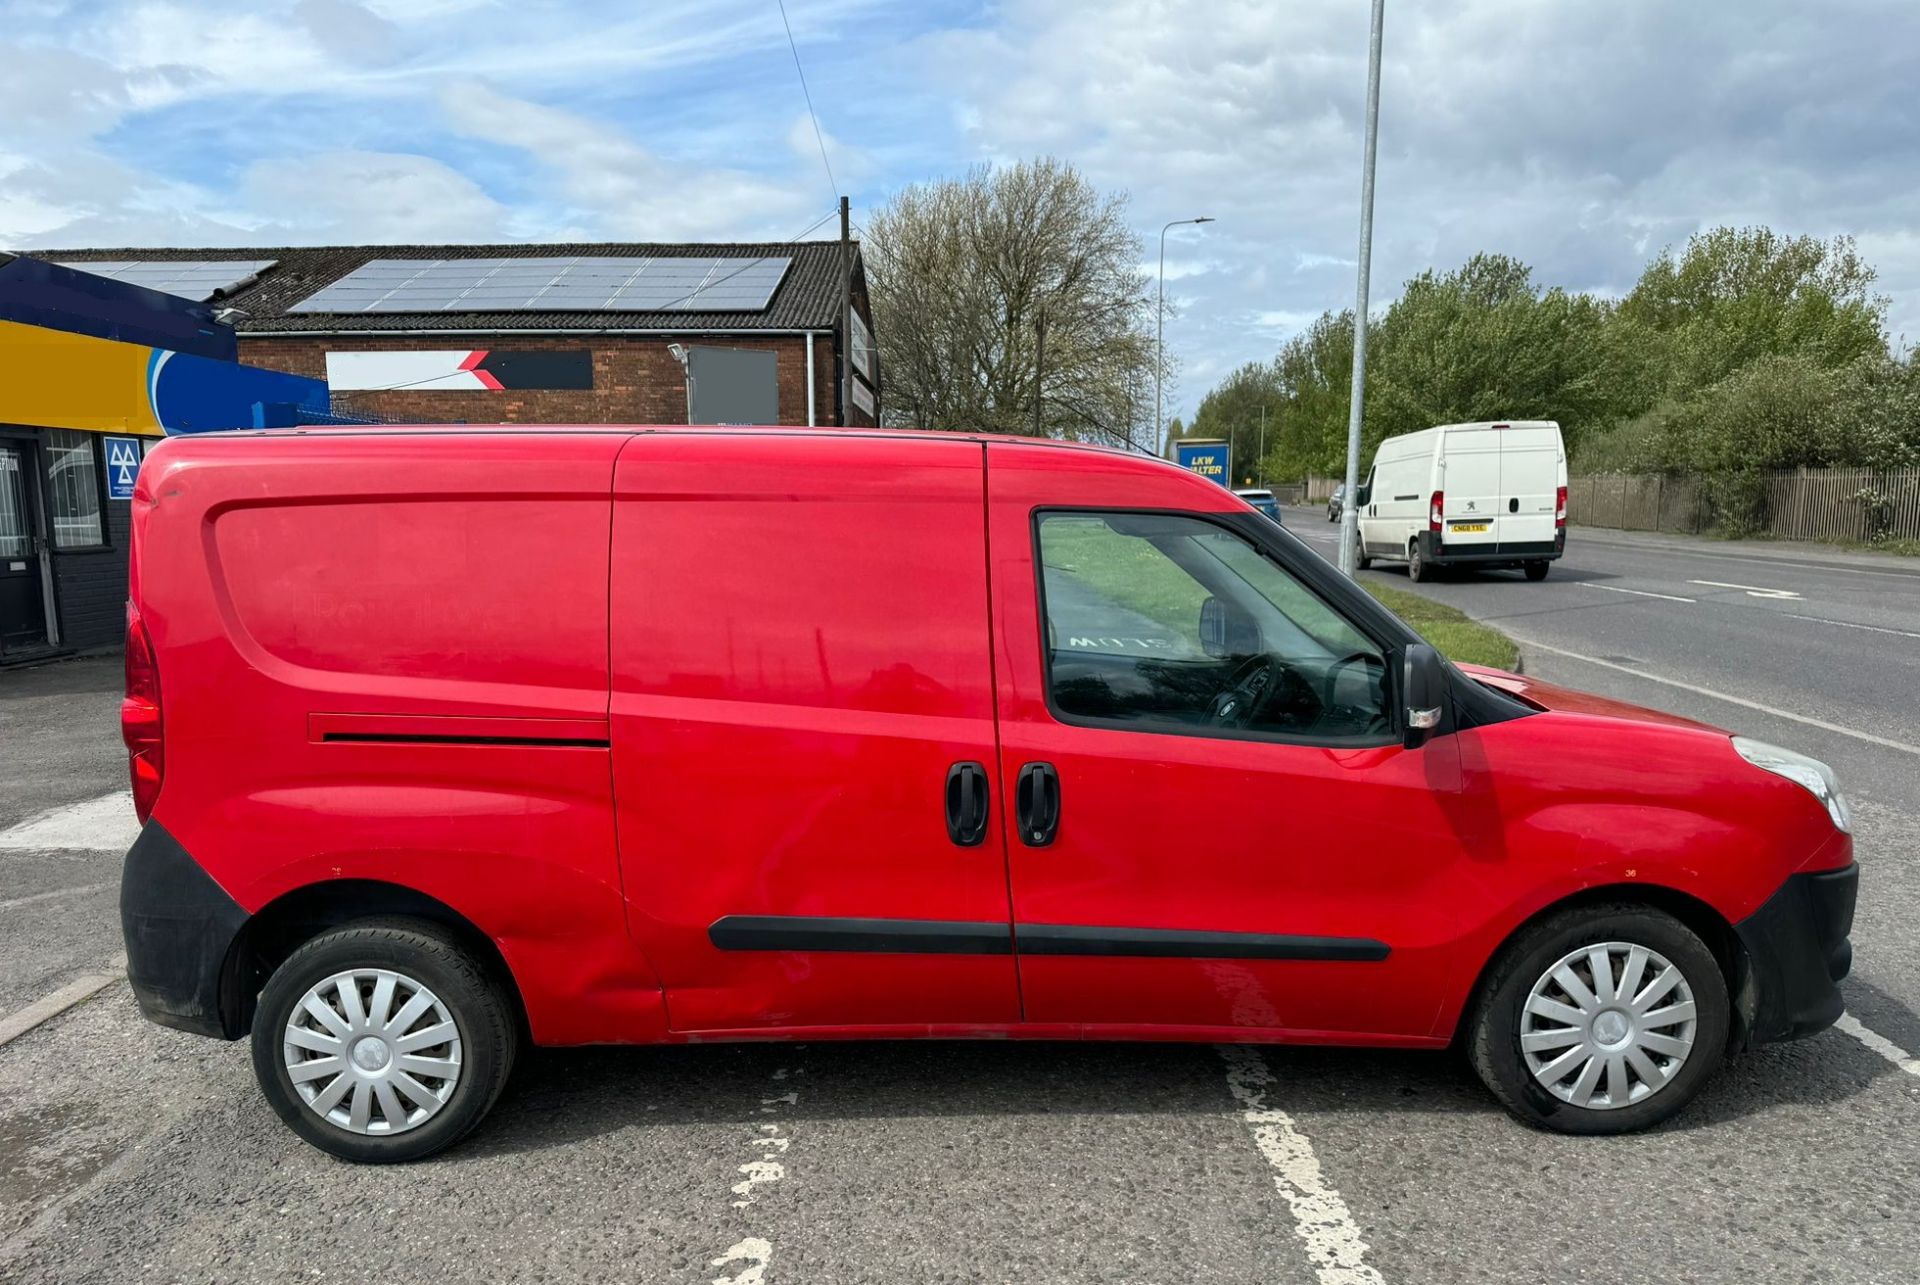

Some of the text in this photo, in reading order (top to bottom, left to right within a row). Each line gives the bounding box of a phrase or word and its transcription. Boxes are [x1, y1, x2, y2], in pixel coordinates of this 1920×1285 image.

[1191, 456, 1215, 465] LKW
[1190, 465, 1222, 475] ALTER
[1625, 869, 1637, 878] 36
